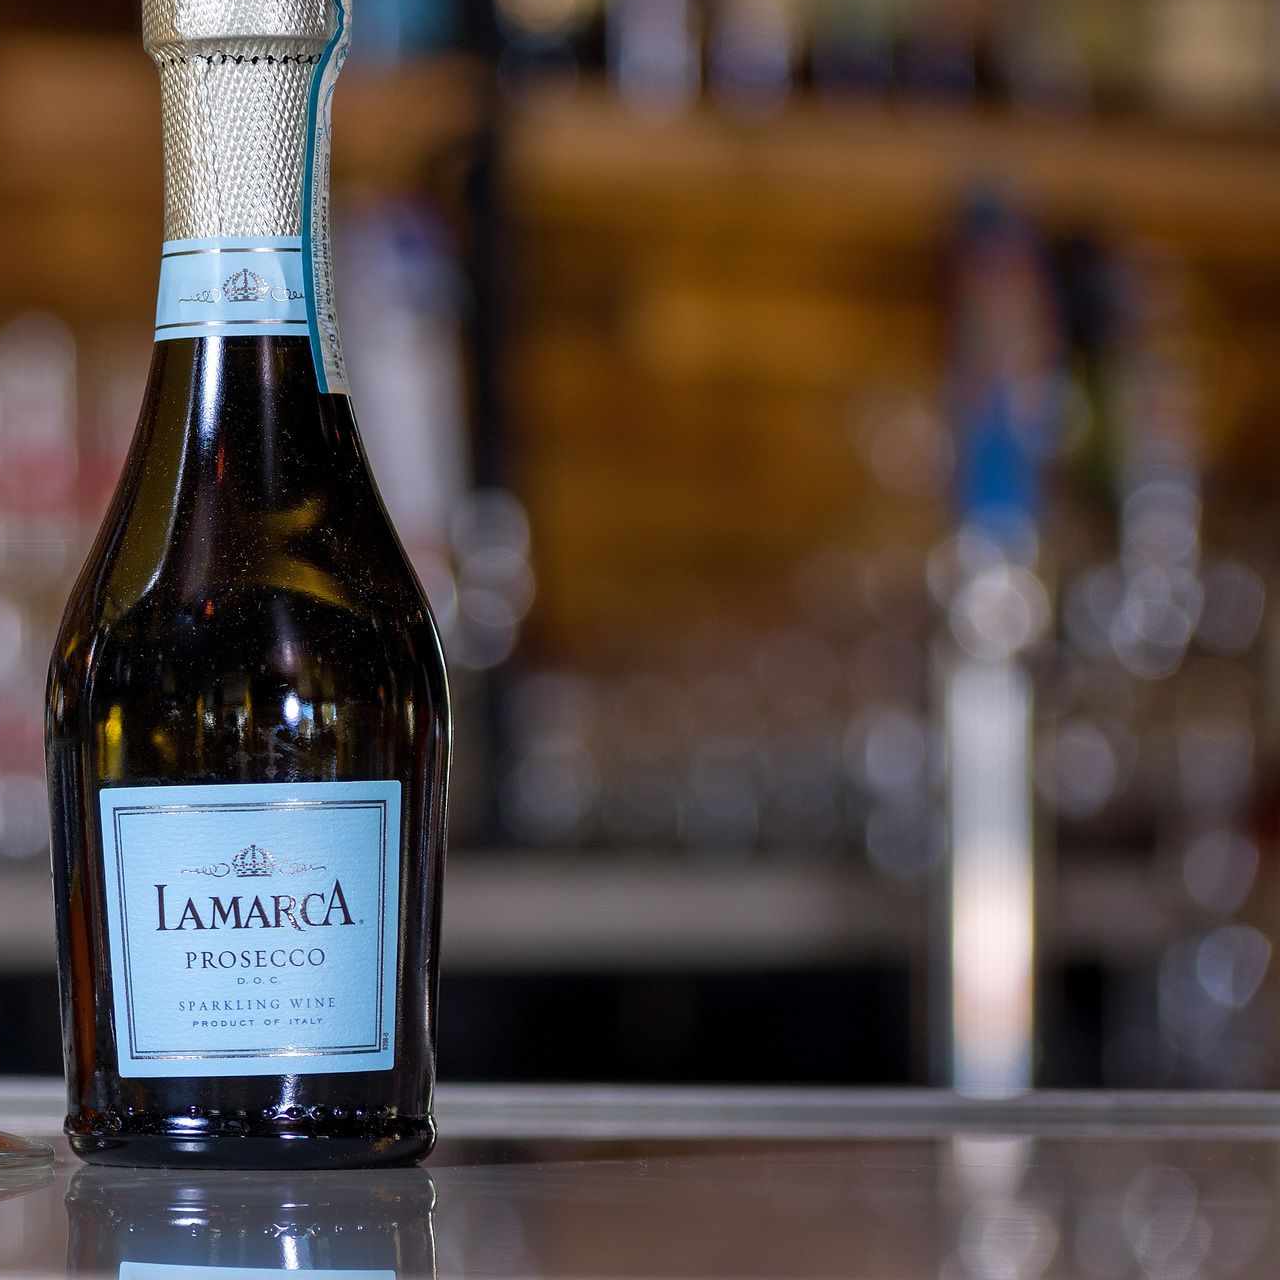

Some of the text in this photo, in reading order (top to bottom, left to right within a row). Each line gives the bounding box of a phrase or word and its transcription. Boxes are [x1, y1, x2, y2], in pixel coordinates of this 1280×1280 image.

[311, 221, 320, 258] Origine
[185, 948, 326, 969] PROSECCO
[179, 997, 336, 1012] SPARKLING WINE
[192, 1017, 323, 1028] PRODUCT OF ITALY
